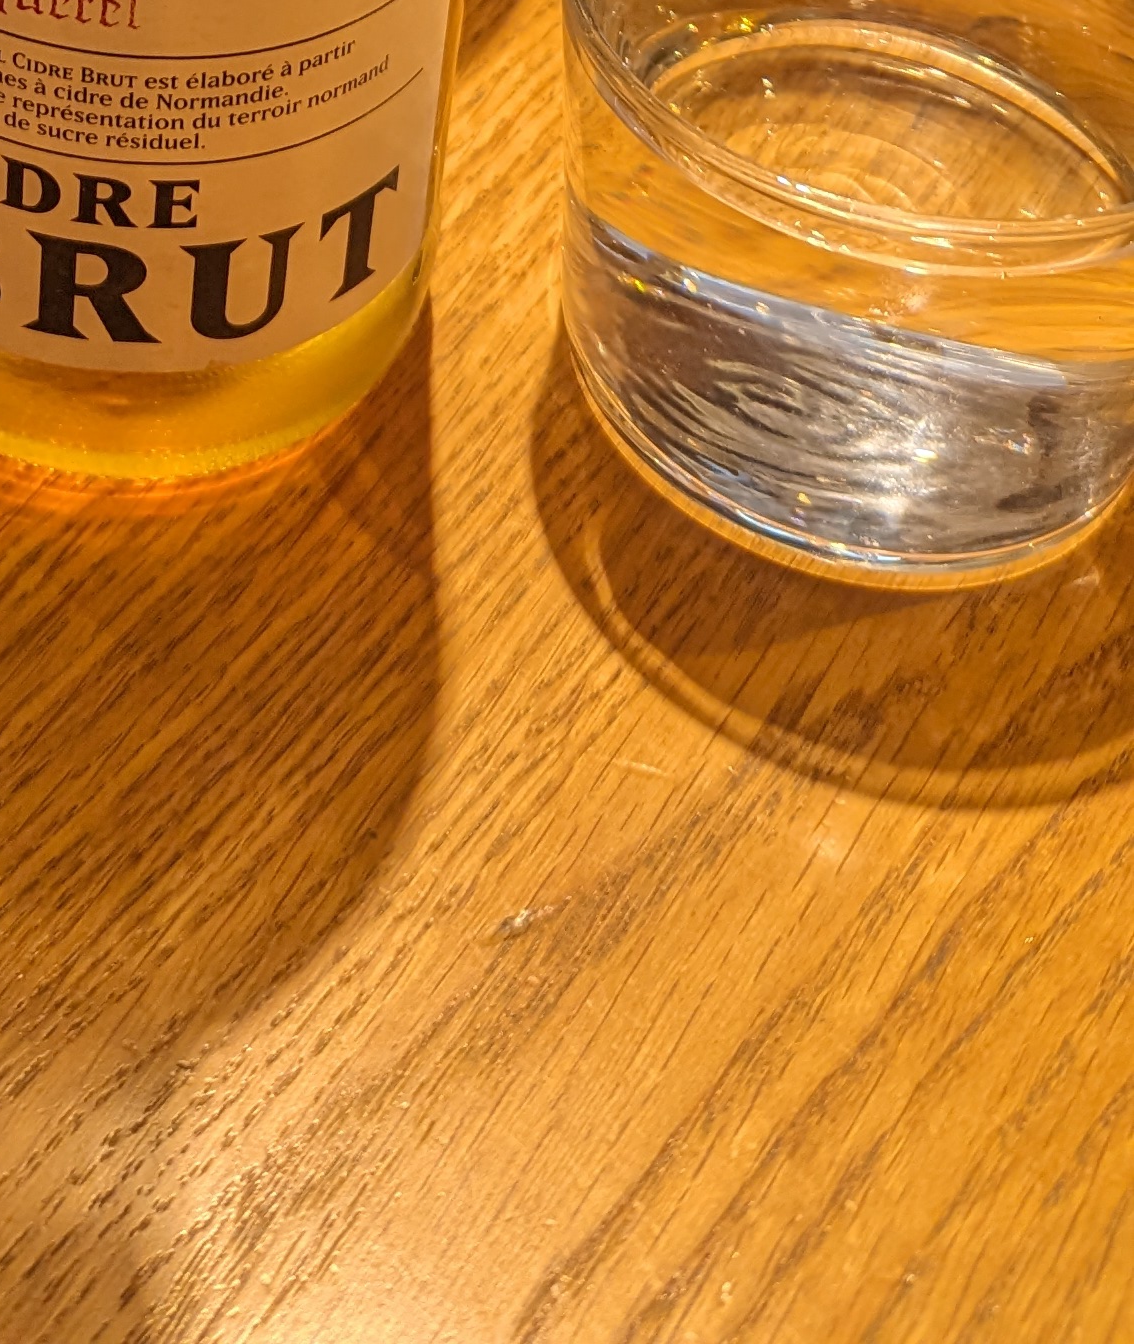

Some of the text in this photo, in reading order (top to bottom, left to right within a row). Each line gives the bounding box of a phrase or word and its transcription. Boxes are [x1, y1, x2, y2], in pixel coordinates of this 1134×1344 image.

[144, 75, 179, 90] est
[185, 64, 275, 90] élaboré
[280, 60, 293, 77] à
[298, 40, 356, 77] partir
[12, 96, 184, 130] représentation
[192, 114, 221, 129] du
[229, 98, 302, 126] terroir
[307, 54, 390, 109] normand
[34, 78, 46, 95] à
[54, 86, 113, 107] cidre
[120, 92, 149, 109] de
[156, 85, 289, 110] Normandie.
[4, 111, 30, 130] de
[36, 122, 98, 145] sucre
[105, 132, 206, 150] résiduel.
